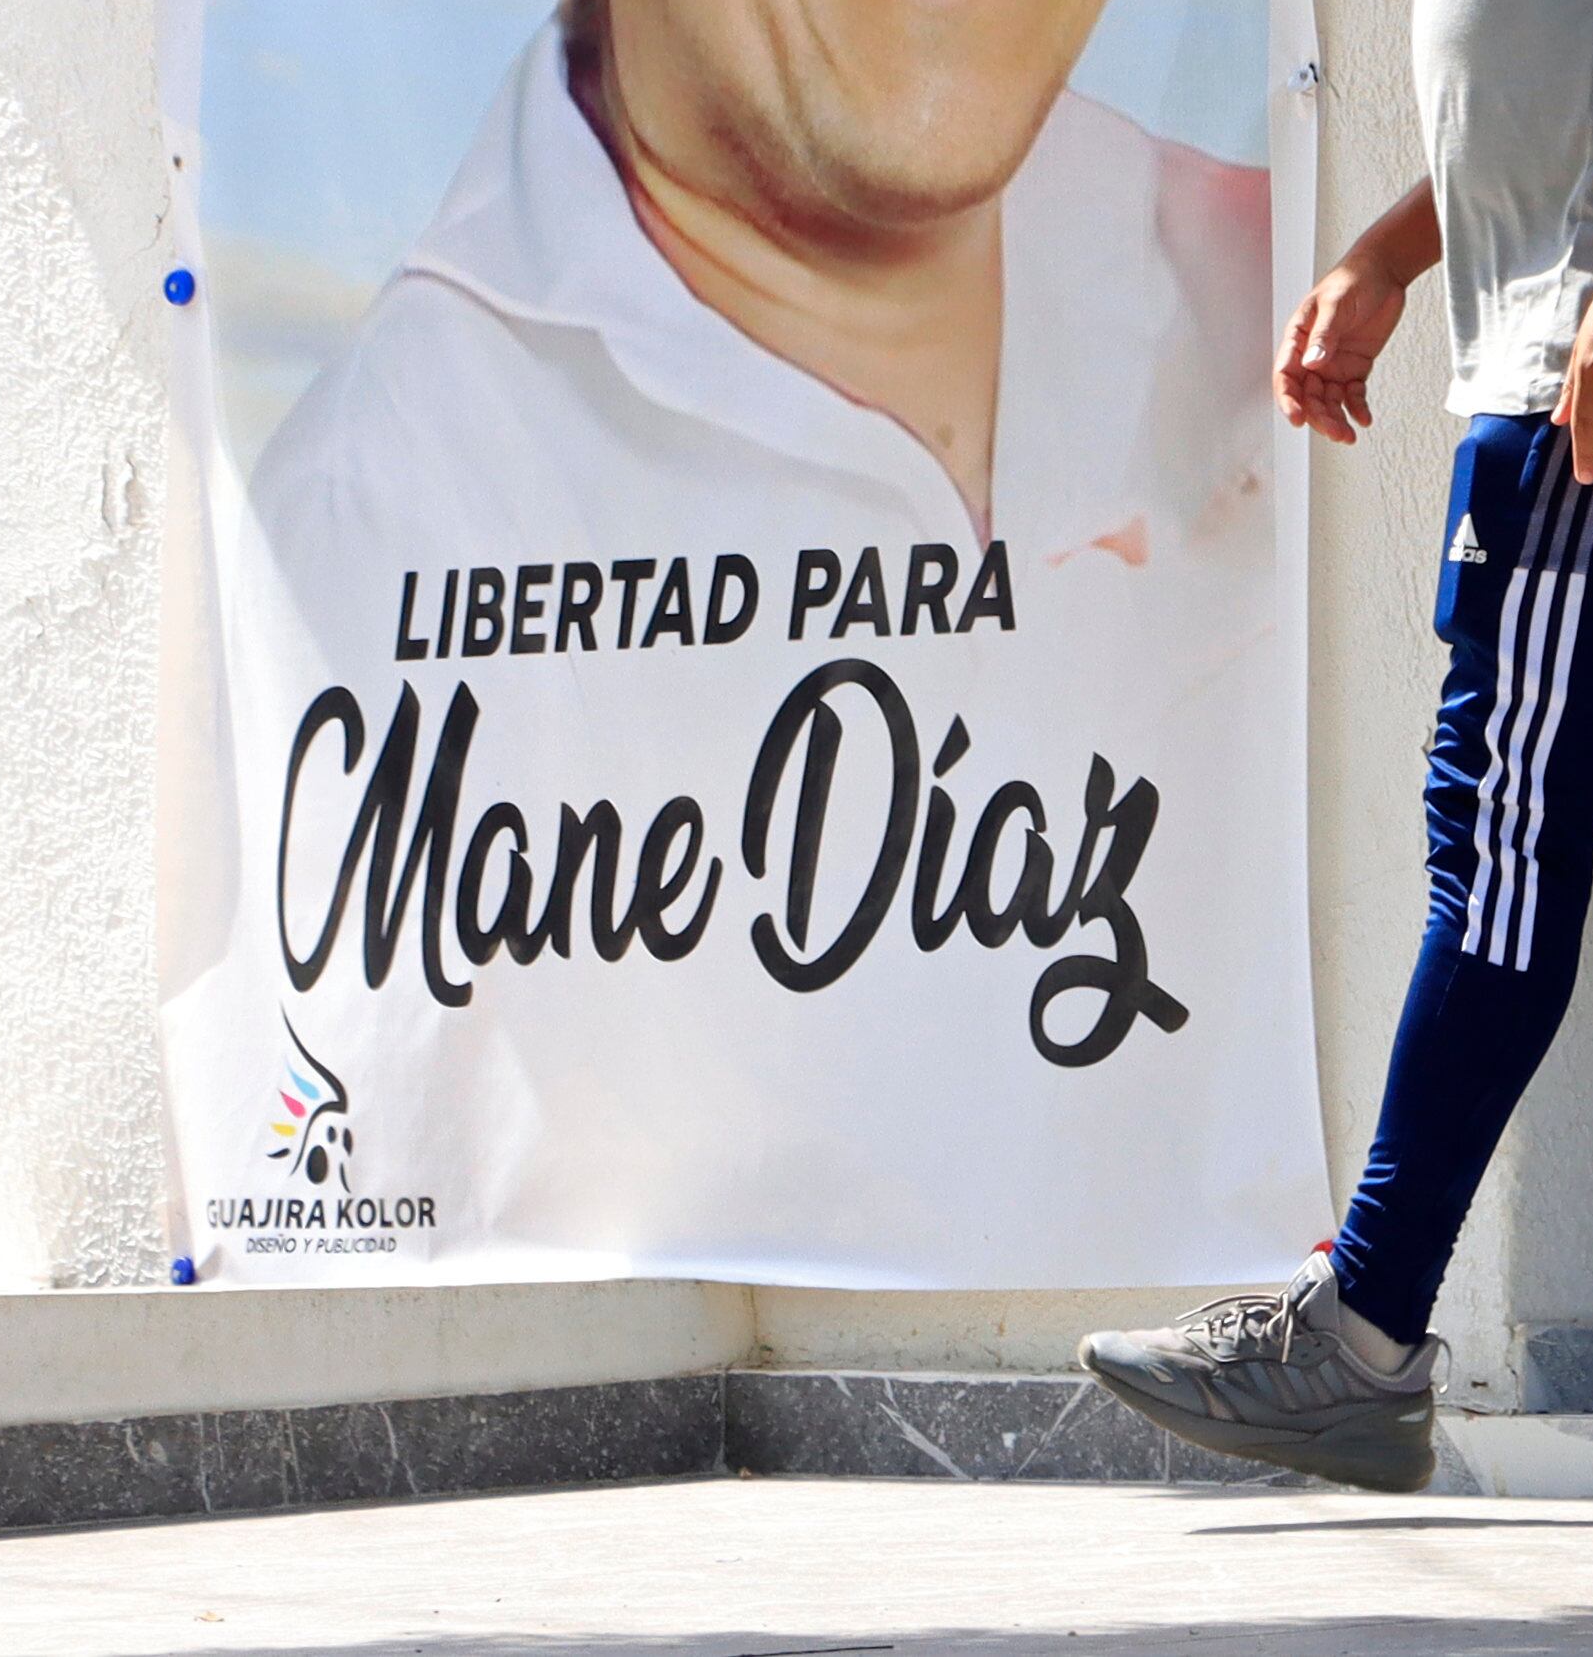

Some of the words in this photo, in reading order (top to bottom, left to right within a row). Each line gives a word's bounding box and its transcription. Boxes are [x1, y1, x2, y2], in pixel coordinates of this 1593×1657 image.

[395, 553, 759, 661] LIBERTAD
[788, 540, 1016, 641] PARA
[278, 678, 723, 1008] Mane
[741, 658, 1190, 1068] Díaz
[207, 1198, 327, 1230] GUAJIRA
[336, 1197, 437, 1229] KOLOR
[246, 1233, 297, 1254] DISEÑO
[302, 1238, 313, 1254] Y
[315, 1237, 398, 1254] PUBLICIDAD
